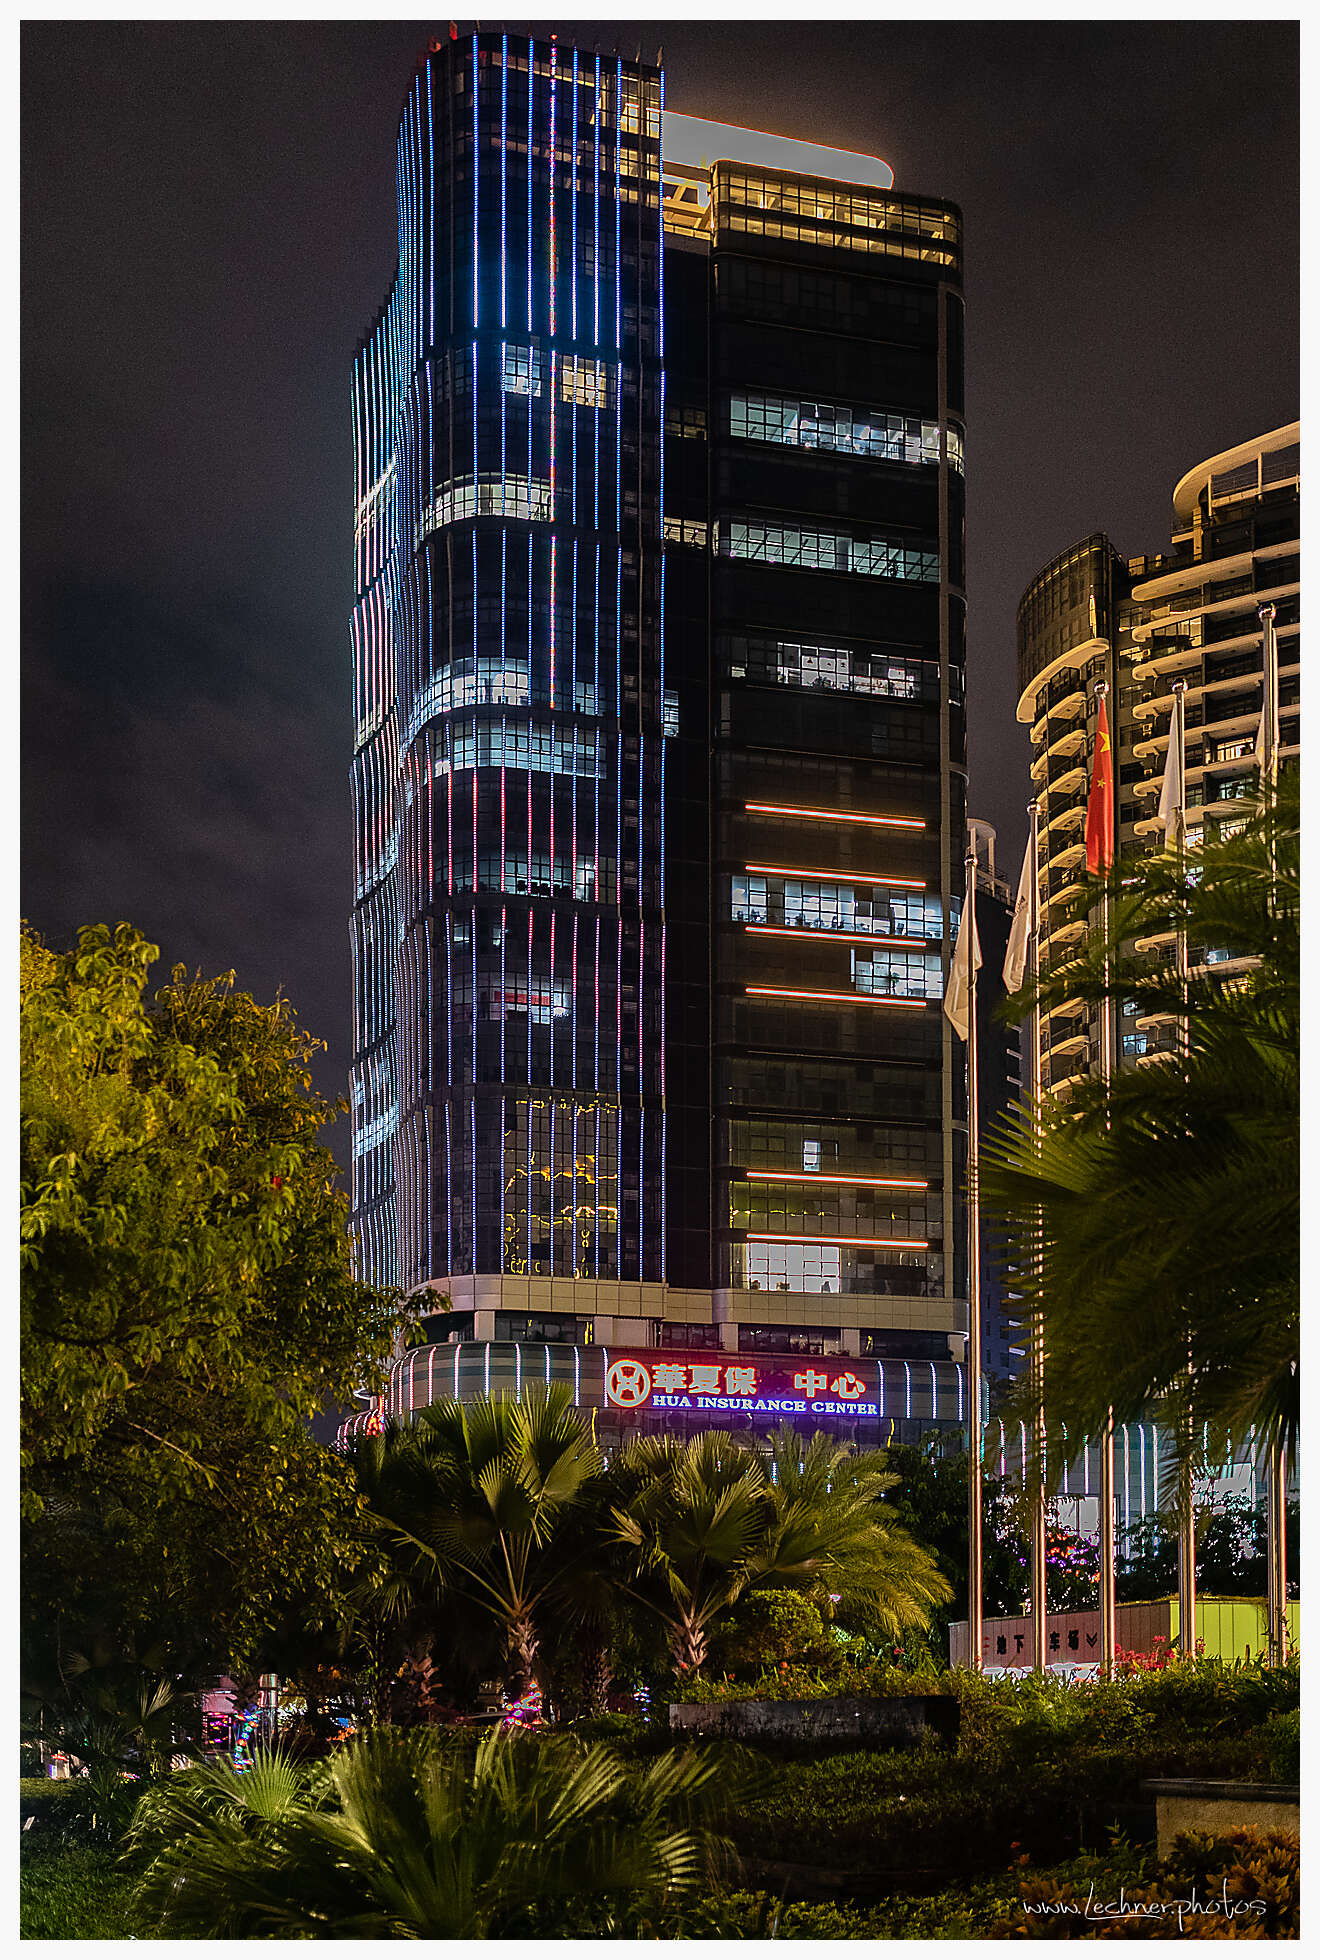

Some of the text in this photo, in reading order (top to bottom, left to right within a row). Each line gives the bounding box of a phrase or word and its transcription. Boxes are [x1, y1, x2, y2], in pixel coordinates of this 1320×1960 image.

[652, 1395, 878, 1415] HUA INSURANCE CENTER
